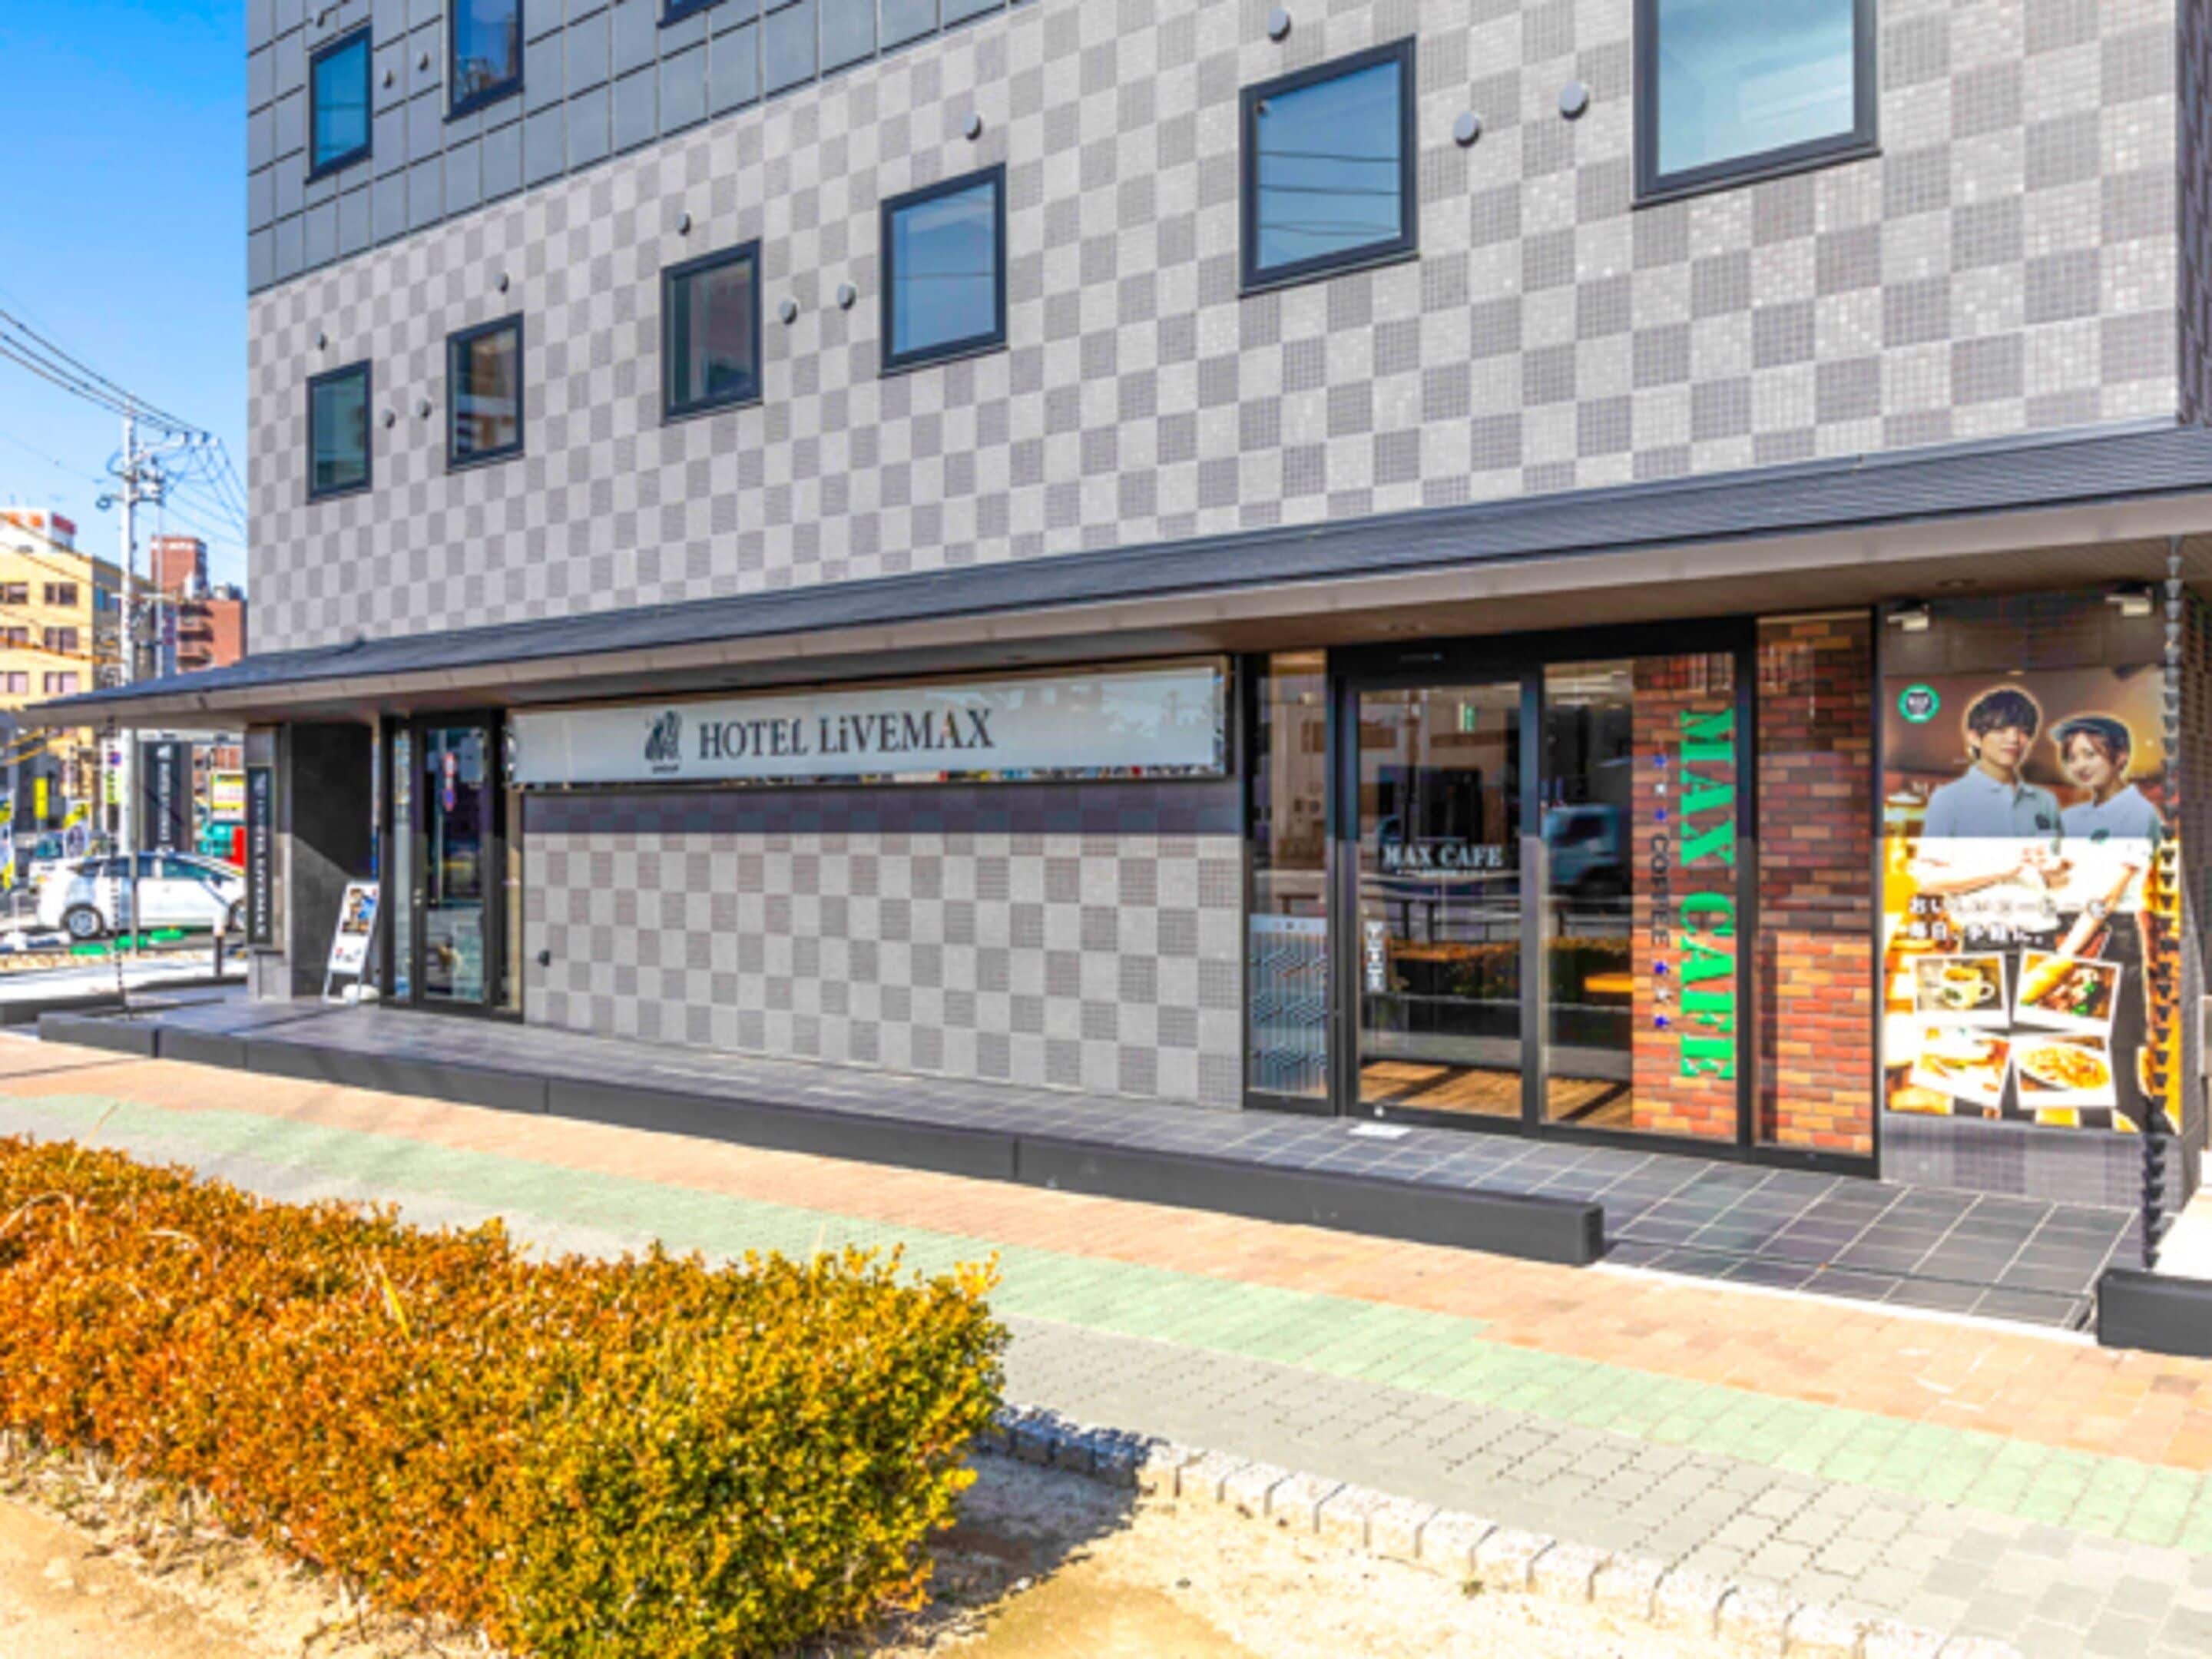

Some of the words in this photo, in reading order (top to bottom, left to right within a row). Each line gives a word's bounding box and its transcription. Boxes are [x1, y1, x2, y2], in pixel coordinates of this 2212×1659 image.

[698, 717, 810, 760] HOTEL
[818, 707, 996, 755] LiVEMAX
[1680, 707, 1735, 867] MAX
[1383, 843, 1432, 867] MAX
[1439, 843, 1503, 868] CAFE
[1651, 833, 1670, 946] COFFEE
[1680, 891, 1735, 1080] CAFE
